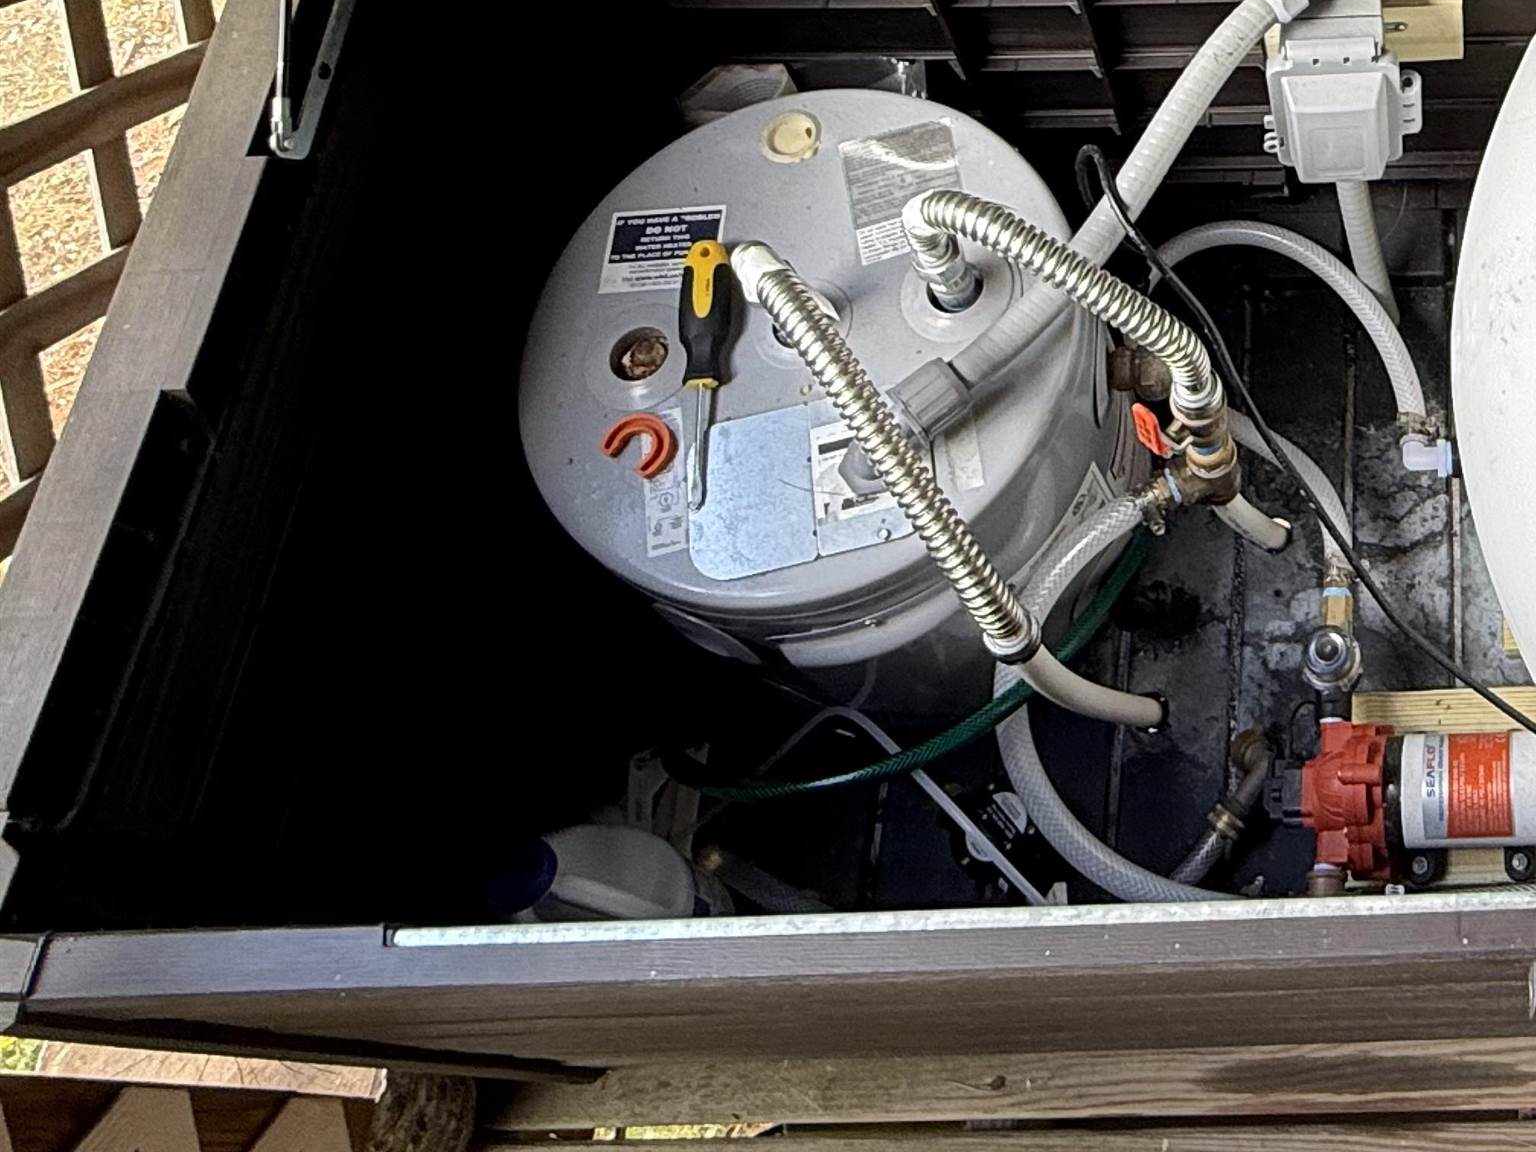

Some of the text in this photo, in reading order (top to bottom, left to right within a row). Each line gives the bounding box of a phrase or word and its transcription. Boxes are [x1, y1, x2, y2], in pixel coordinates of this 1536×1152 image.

[647, 216, 669, 224] HAVE
[645, 224, 688, 235] DO NOT
[1425, 746, 1436, 798] SEAFLO
